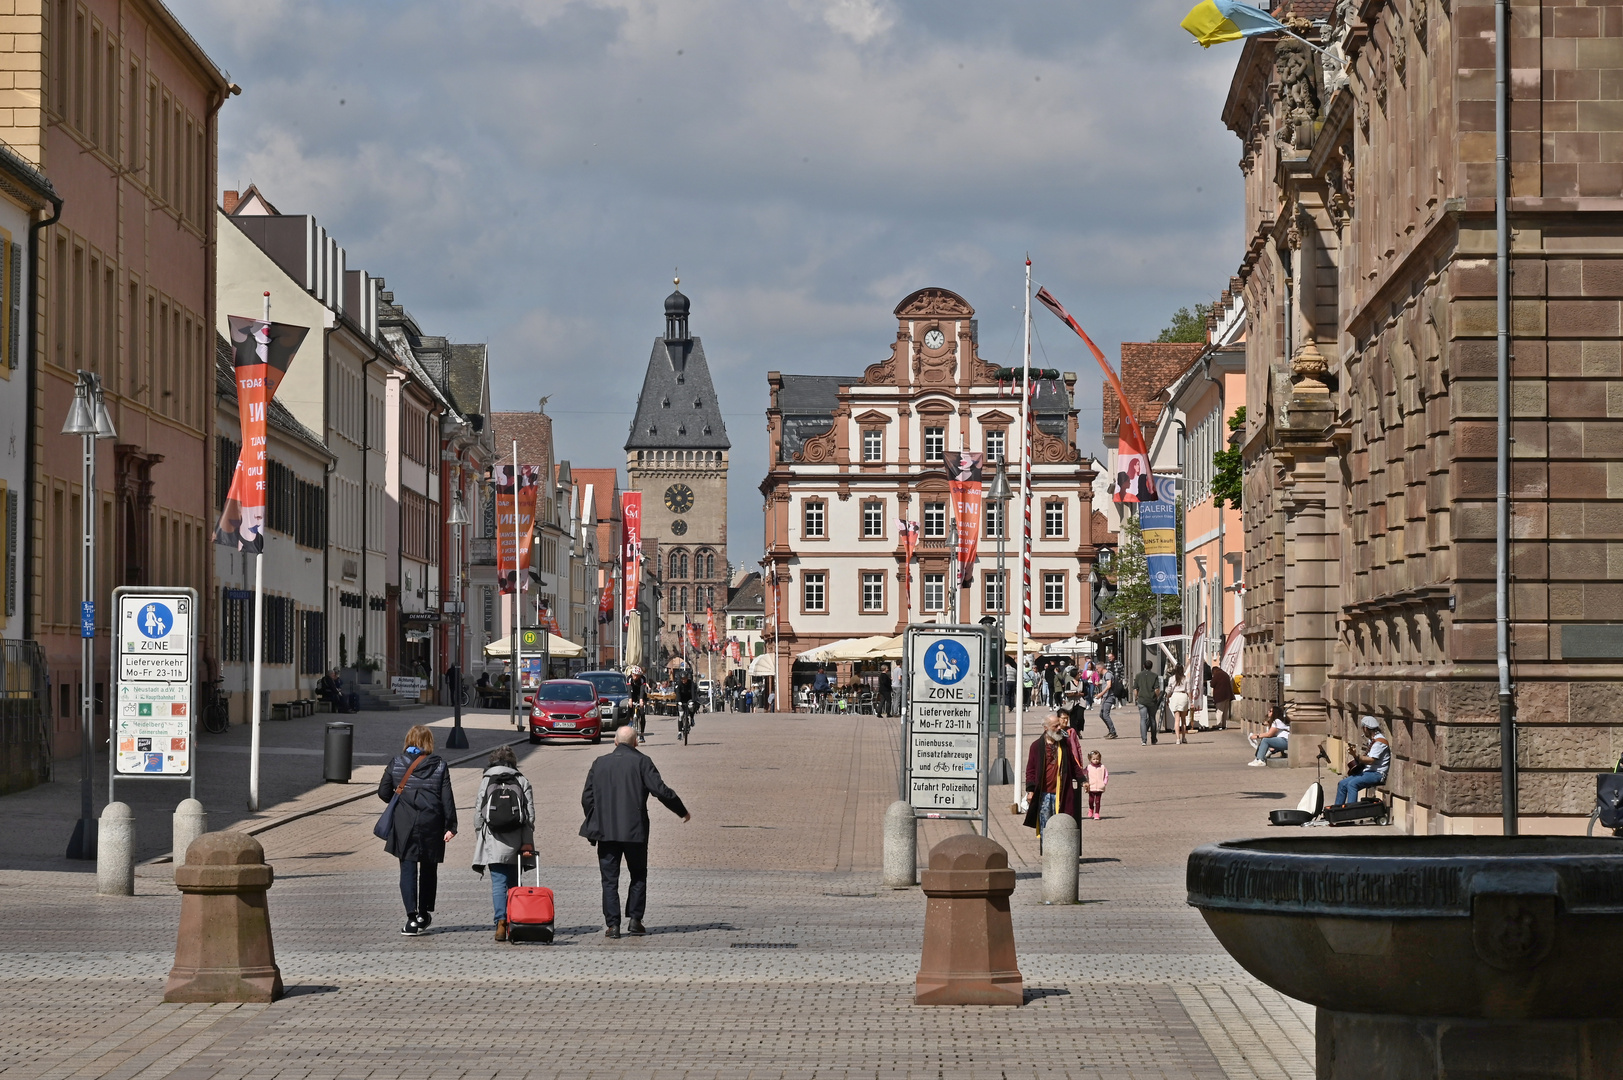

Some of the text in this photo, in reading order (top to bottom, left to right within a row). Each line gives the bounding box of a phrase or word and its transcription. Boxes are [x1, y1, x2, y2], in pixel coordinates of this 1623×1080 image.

[1140, 504, 1174, 513] GALERIE
[126, 658, 184, 667] Lieferverkehr
[126, 668, 153, 677] Mo-Fr
[928, 687, 964, 699] ZONE
[919, 706, 972, 717] Lieferverkehr
[919, 719, 971, 729] Mo-Fr 23-11 h
[917, 749, 973, 760] Einsatzfahrzeuge
[919, 763, 931, 771] und
[952, 763, 964, 772] frei
[913, 782, 976, 792] Zufahrt Polizeihof
[934, 793, 955, 805] frei
